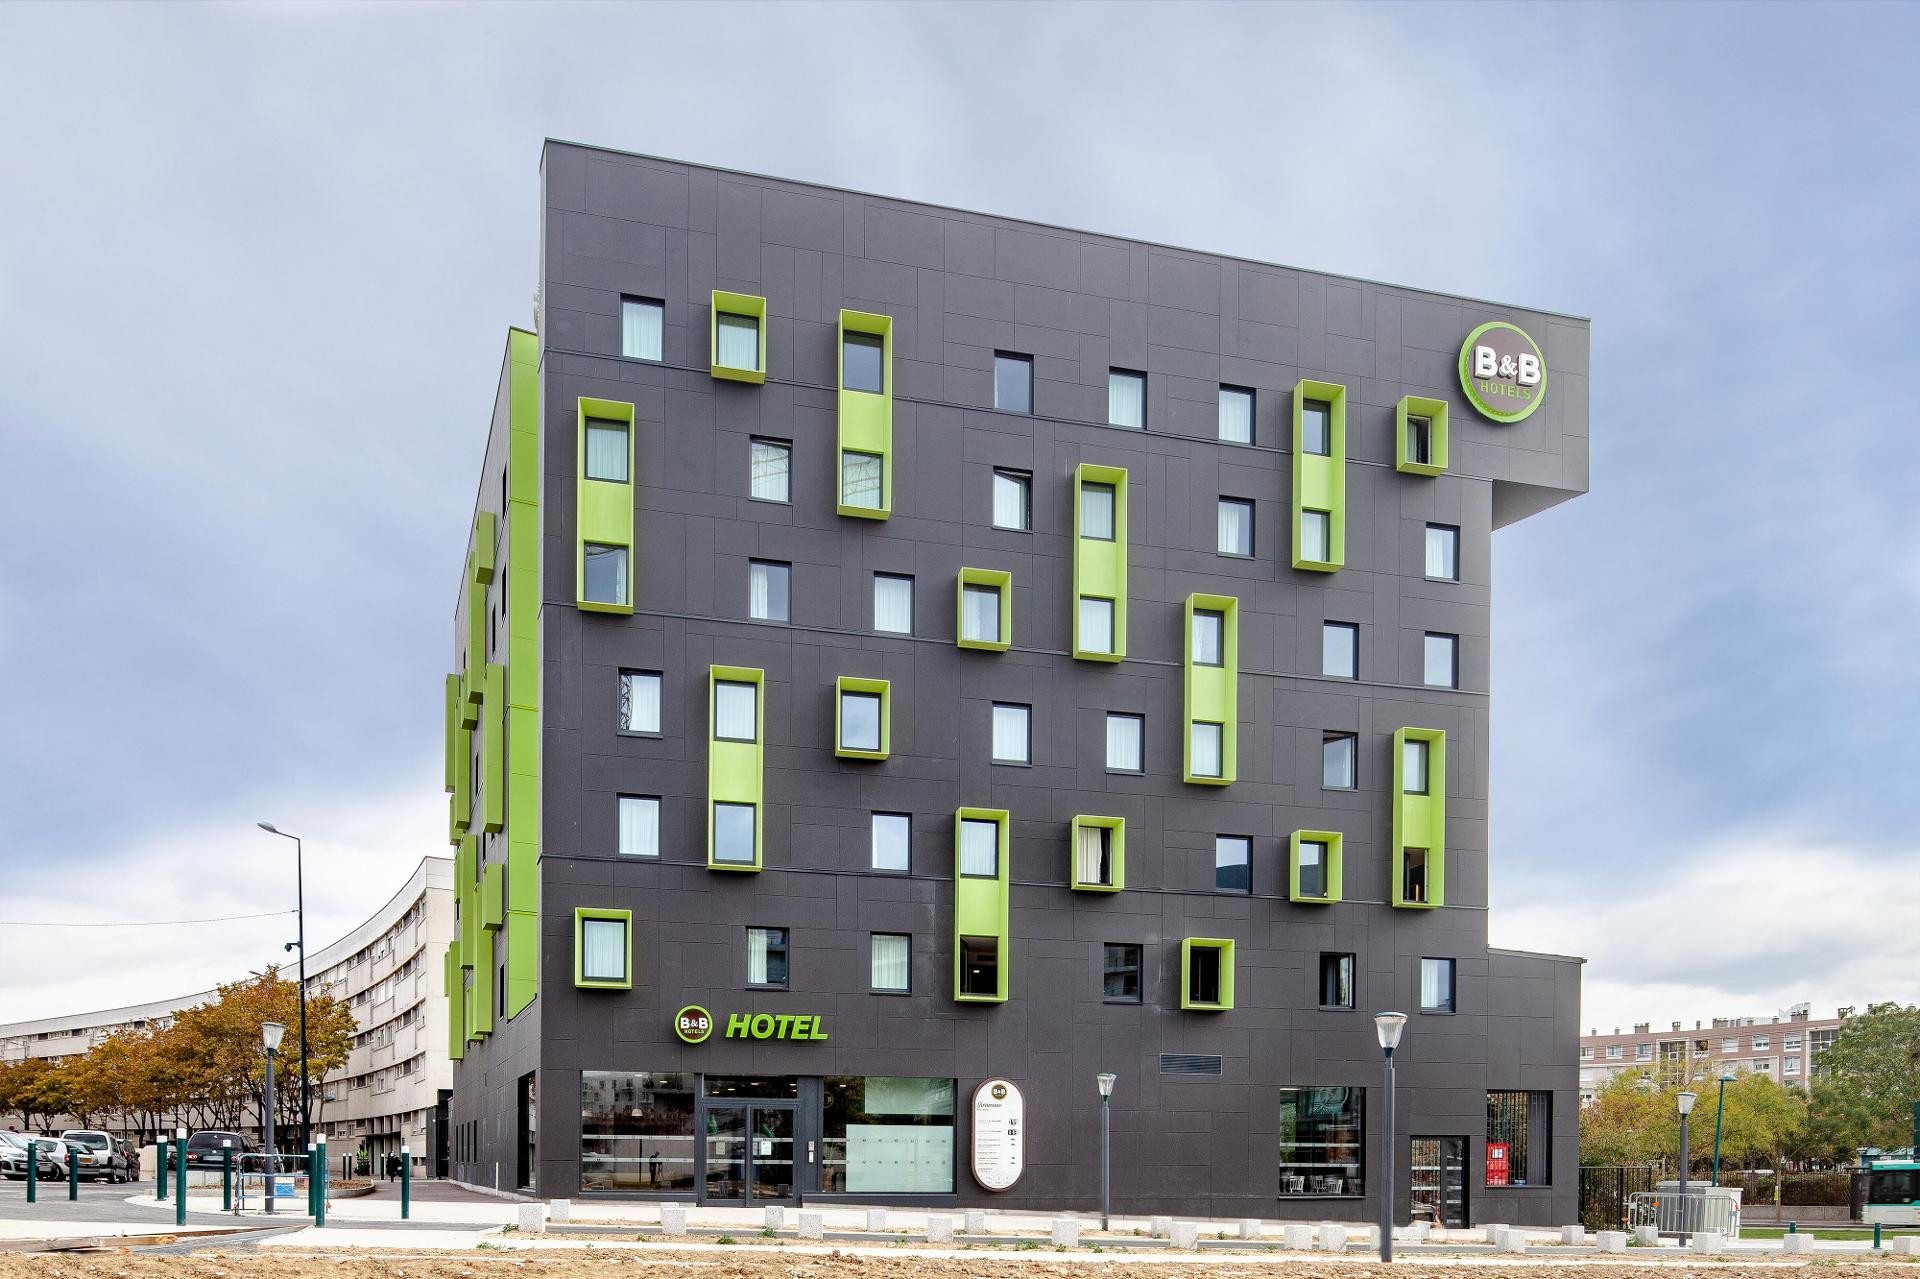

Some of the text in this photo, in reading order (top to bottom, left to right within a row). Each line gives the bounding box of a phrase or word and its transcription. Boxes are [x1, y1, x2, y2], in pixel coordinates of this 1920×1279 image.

[1475, 345, 1541, 386] B&B
[1480, 381, 1531, 400] HOTELS
[680, 1017, 708, 1028] B&B
[726, 1013, 828, 1040] HOTEL
